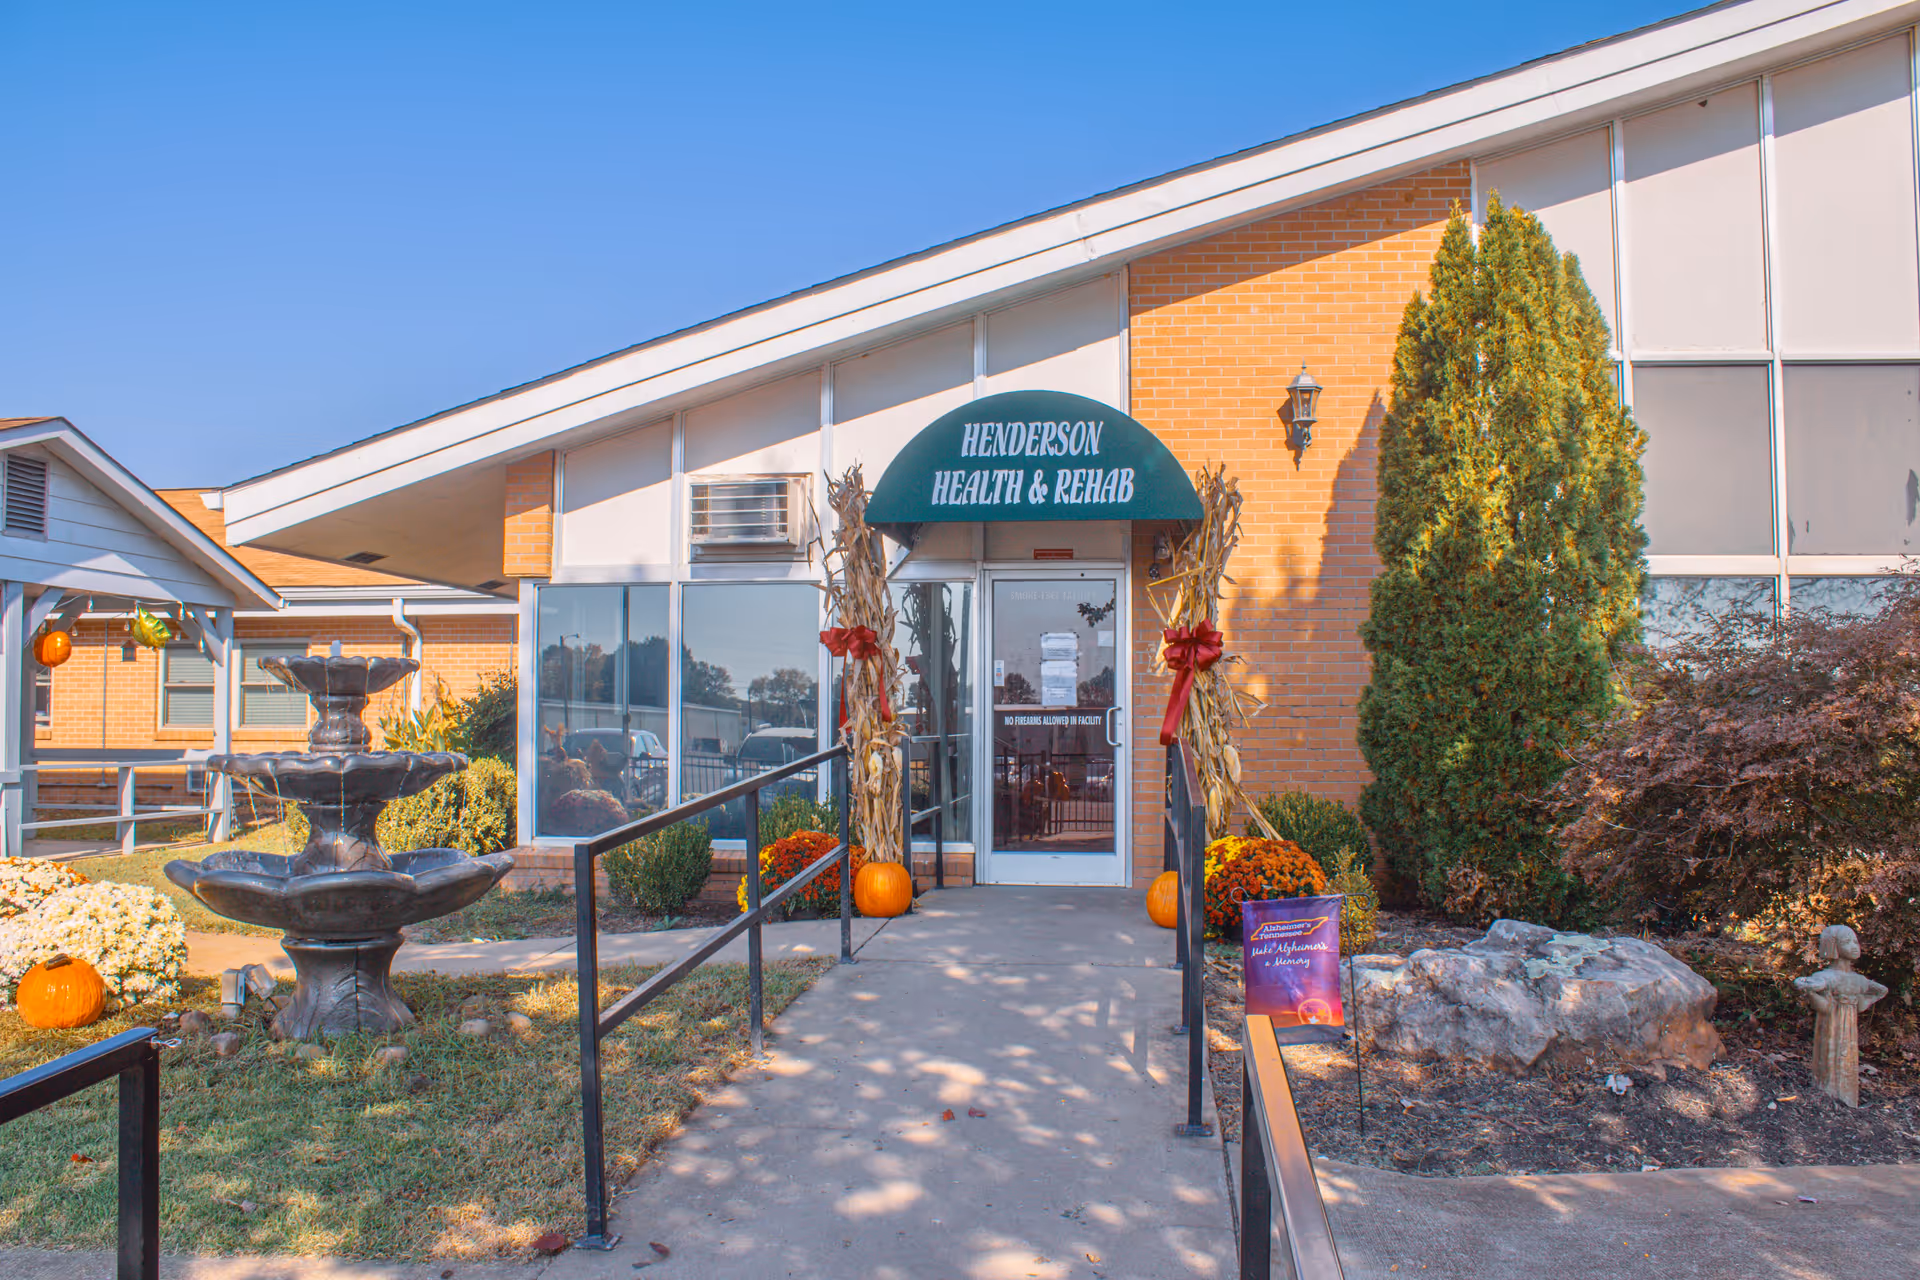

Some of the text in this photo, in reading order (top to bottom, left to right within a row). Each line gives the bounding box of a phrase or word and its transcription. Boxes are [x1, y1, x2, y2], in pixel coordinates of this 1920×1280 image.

[961, 421, 1103, 457] HENDERSON
[931, 468, 1135, 505] HEALTH & REHAB
[1004, 716, 1102, 725] NO FIREARMS ALLOWED IN FACILITY
[1263, 922, 1311, 932] Alzheimer's
[1259, 930, 1302, 939] Tennessee
[1251, 941, 1328, 958] Make Alzheimer's
[1272, 957, 1310, 968] Memory
